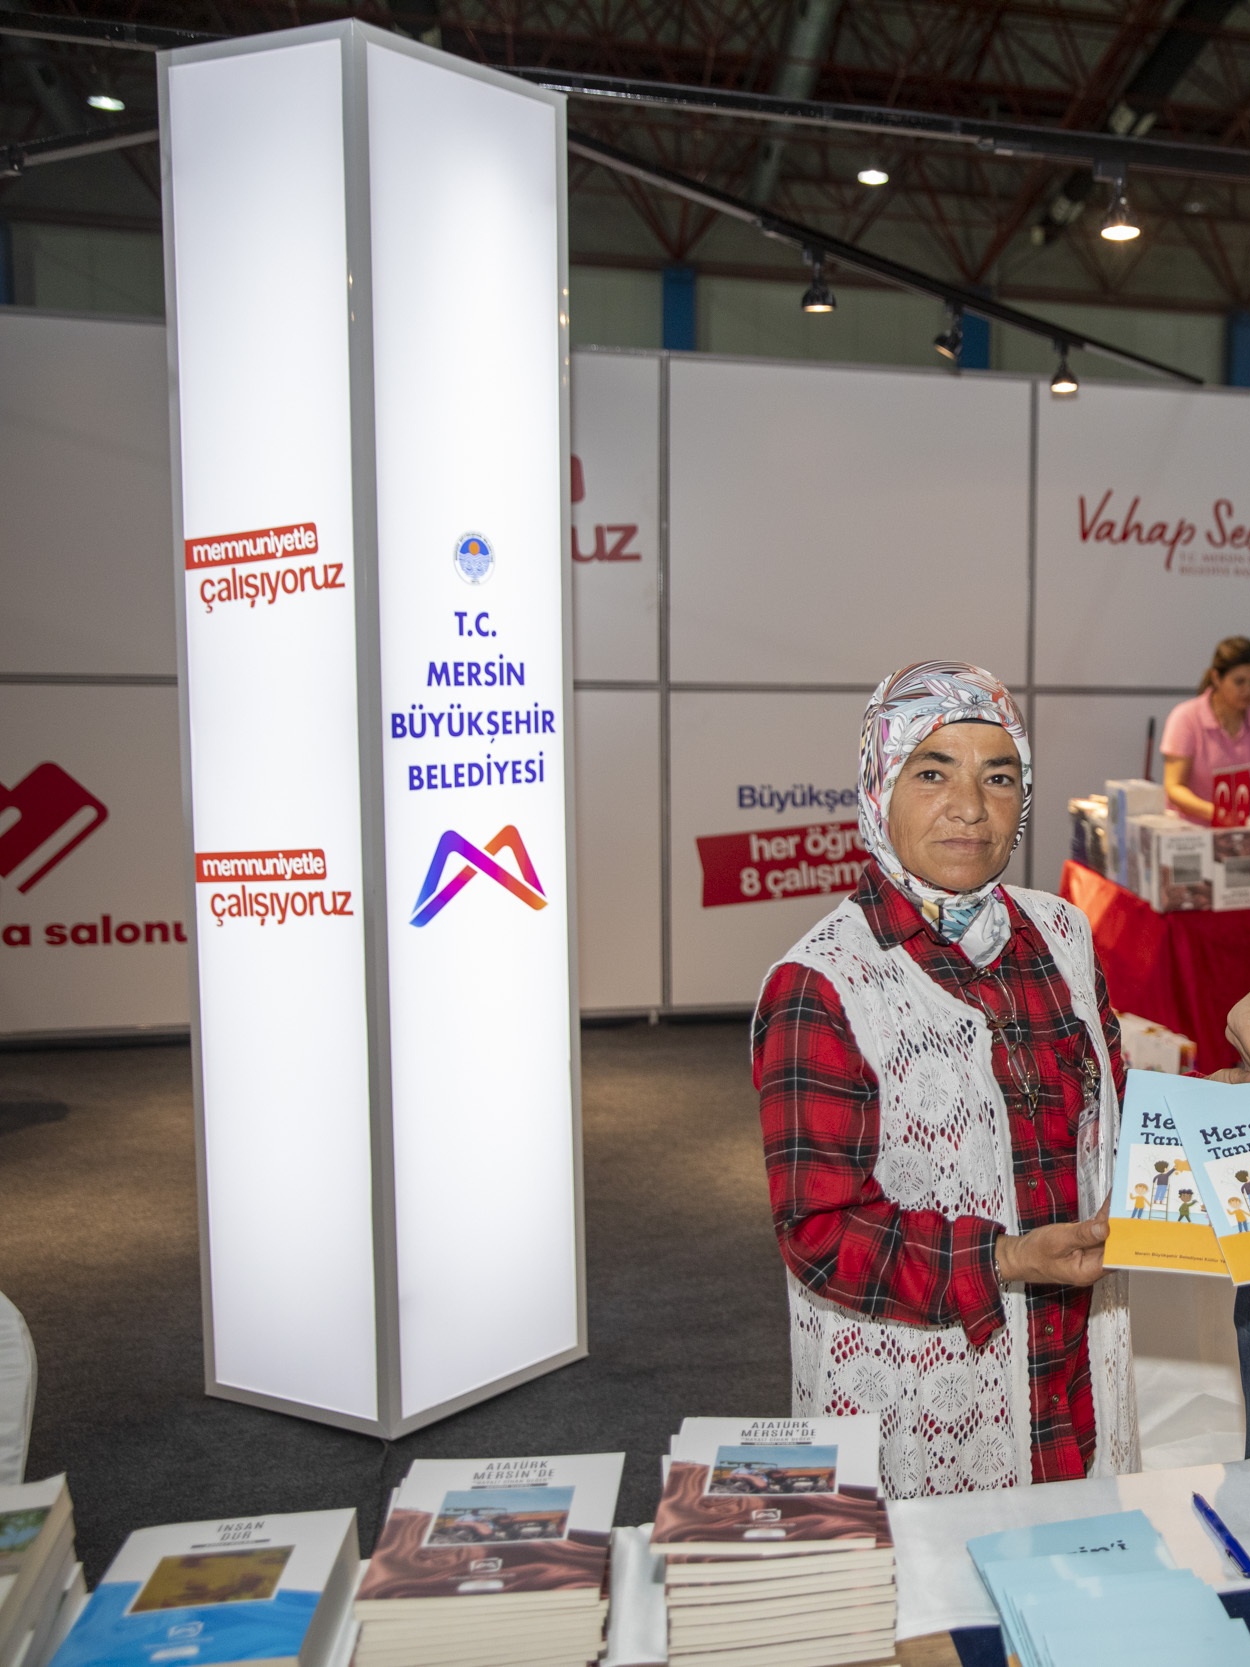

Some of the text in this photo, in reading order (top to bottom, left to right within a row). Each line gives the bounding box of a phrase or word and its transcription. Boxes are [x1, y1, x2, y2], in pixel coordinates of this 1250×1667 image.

[192, 525, 316, 563] memnuniyetle
[571, 523, 643, 564] uz
[1077, 488, 1196, 572] Vahap
[200, 562, 346, 614] çalışıyoruz
[454, 611, 497, 637] T.C.
[427, 653, 525, 687] MERSİN
[391, 701, 556, 744] BÜYÜKŞEHİR
[408, 750, 544, 791] BELEDİYESİ
[750, 833, 800, 862] her
[202, 851, 325, 880] memnuniyetle
[739, 867, 762, 897] 8
[210, 884, 354, 927] çalışıyoruz
[741, 1428, 817, 1437] MERSİN'DE
[751, 1420, 809, 1429] ATATÜRK
[473, 1468, 557, 1480] MERSİN'DE
[486, 1460, 549, 1471] ATATÜRK
